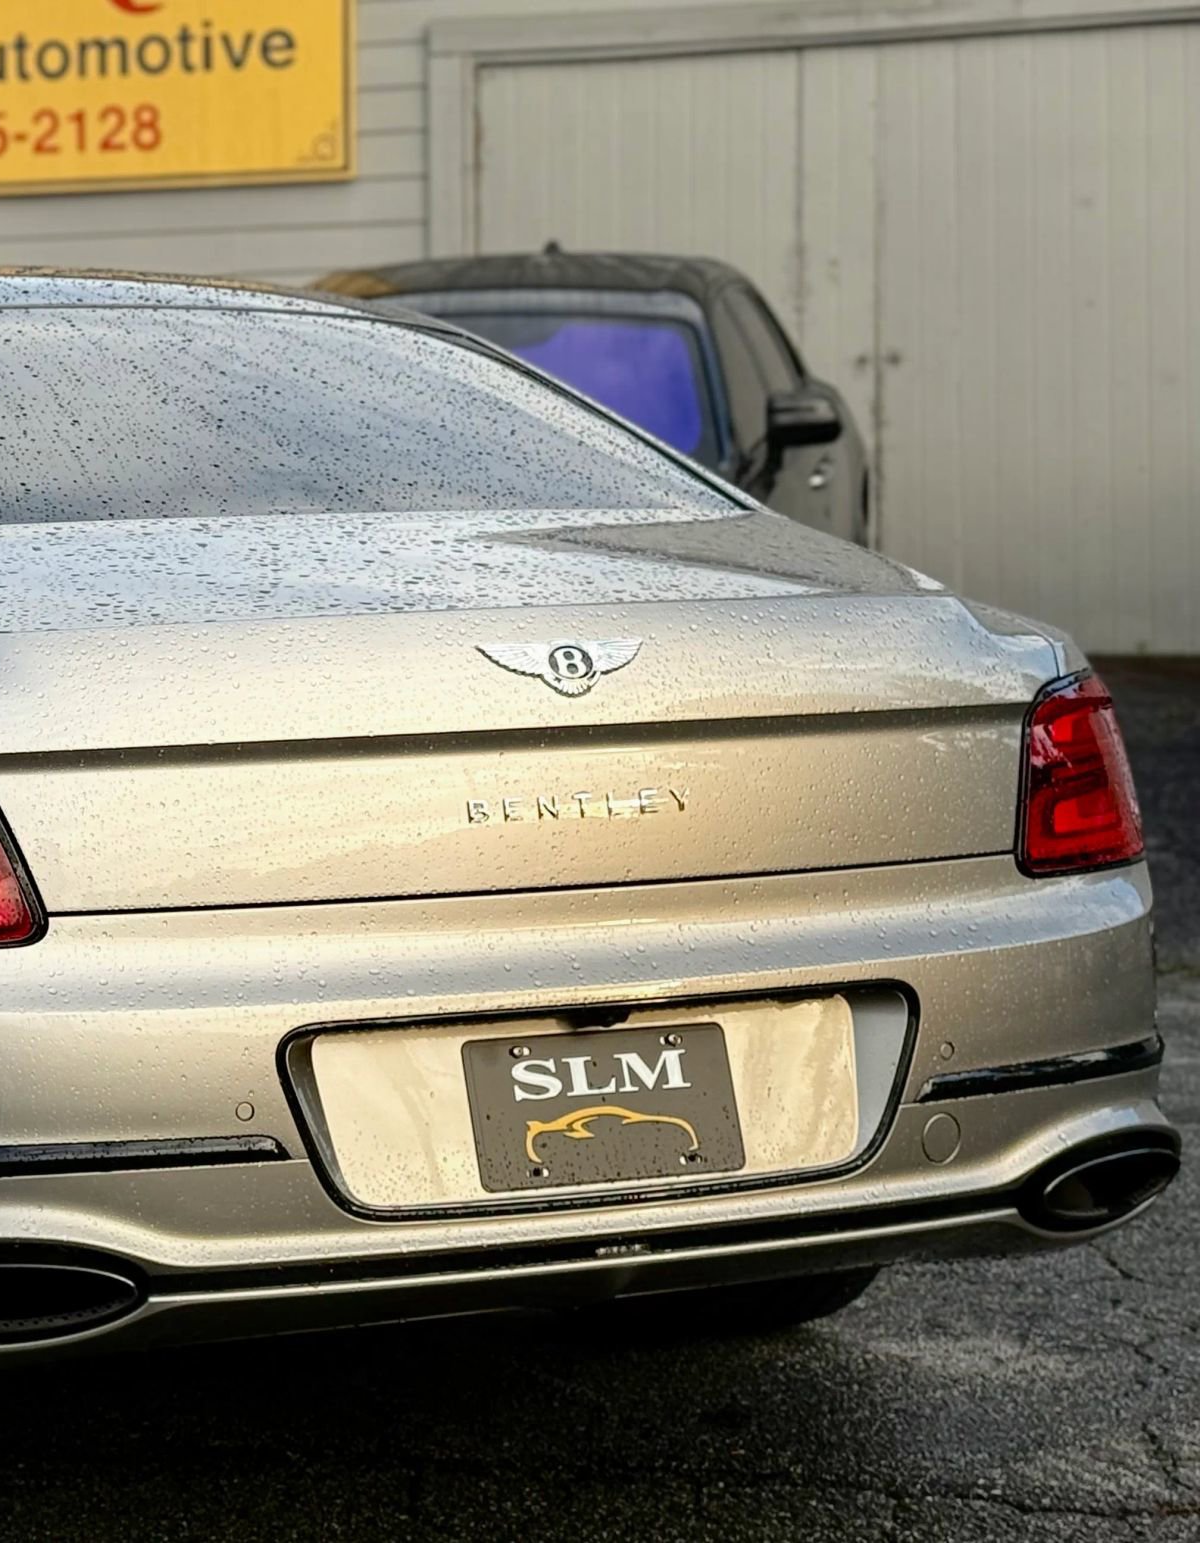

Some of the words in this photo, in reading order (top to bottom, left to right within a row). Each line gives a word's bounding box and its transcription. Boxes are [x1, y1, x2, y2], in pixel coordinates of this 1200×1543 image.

[554, 647, 588, 679] B
[466, 787, 689, 823] BENTLEY
[511, 1049, 691, 1101] SLM
